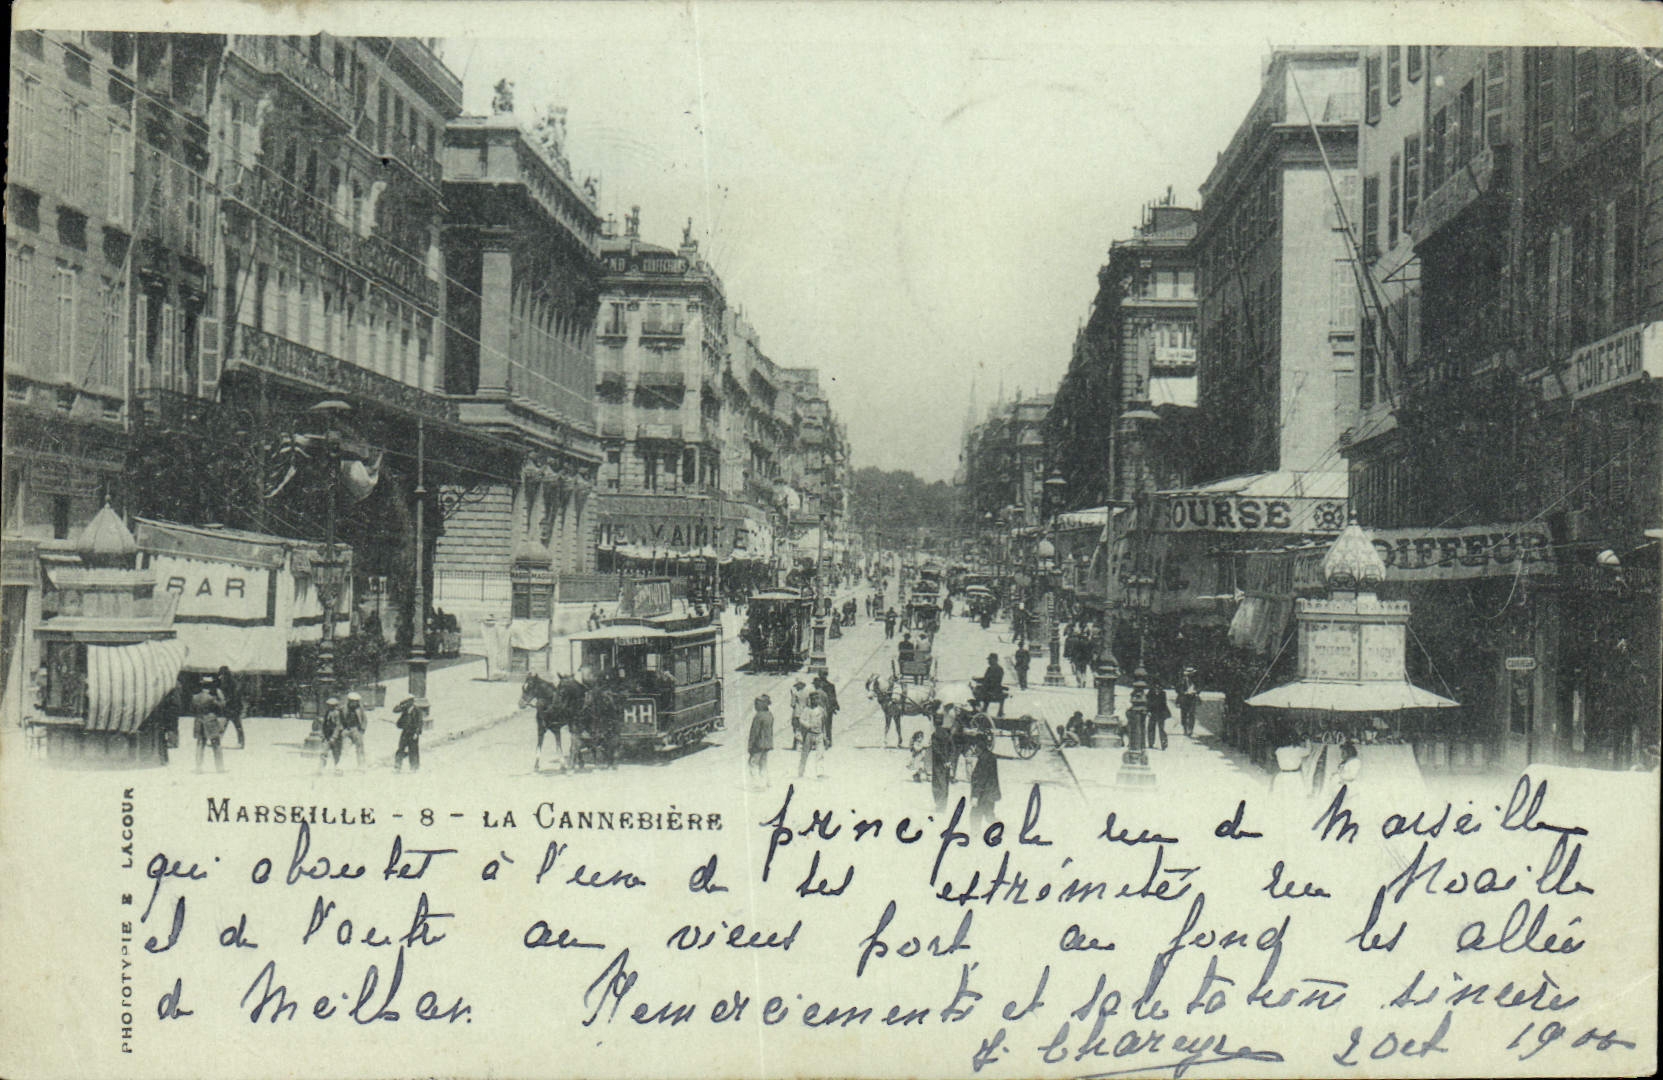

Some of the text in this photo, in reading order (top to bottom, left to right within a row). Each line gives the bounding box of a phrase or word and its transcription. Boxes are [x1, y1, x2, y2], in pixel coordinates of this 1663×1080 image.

[1575, 329, 1642, 393] COIFFEUR
[1167, 499, 1292, 529] OURSE
[167, 575, 246, 599] BAR
[481, 850, 514, 881] à
[1335, 1026, 1358, 1066] 2
